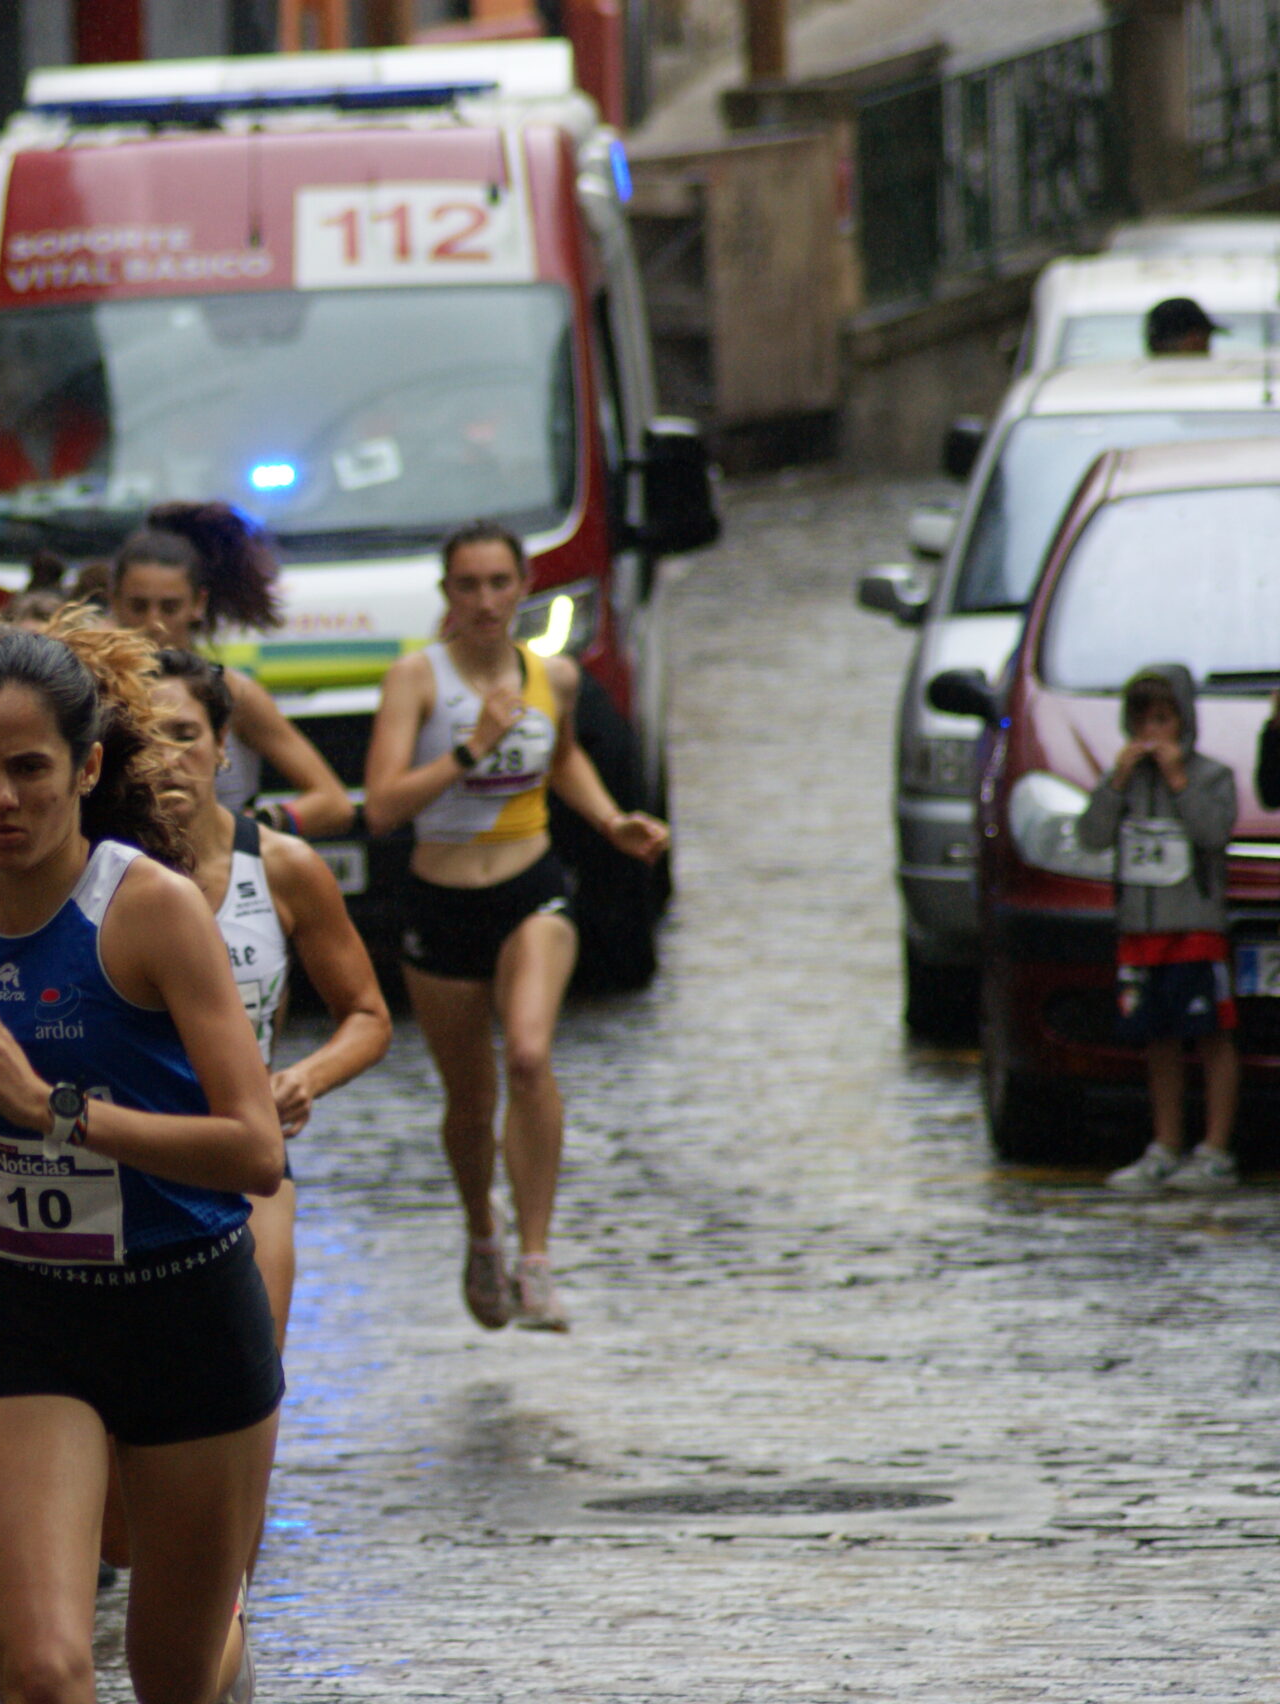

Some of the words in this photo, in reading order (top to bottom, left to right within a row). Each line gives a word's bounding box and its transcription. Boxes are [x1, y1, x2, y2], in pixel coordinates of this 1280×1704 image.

[9, 226, 191, 262] SOPORTE
[319, 201, 493, 266] 112
[6, 257, 117, 292] VITAL
[35, 1020, 84, 1040] ardoi
[6, 1186, 73, 1229] 10
[94, 1260, 181, 1286] ARMOUR
